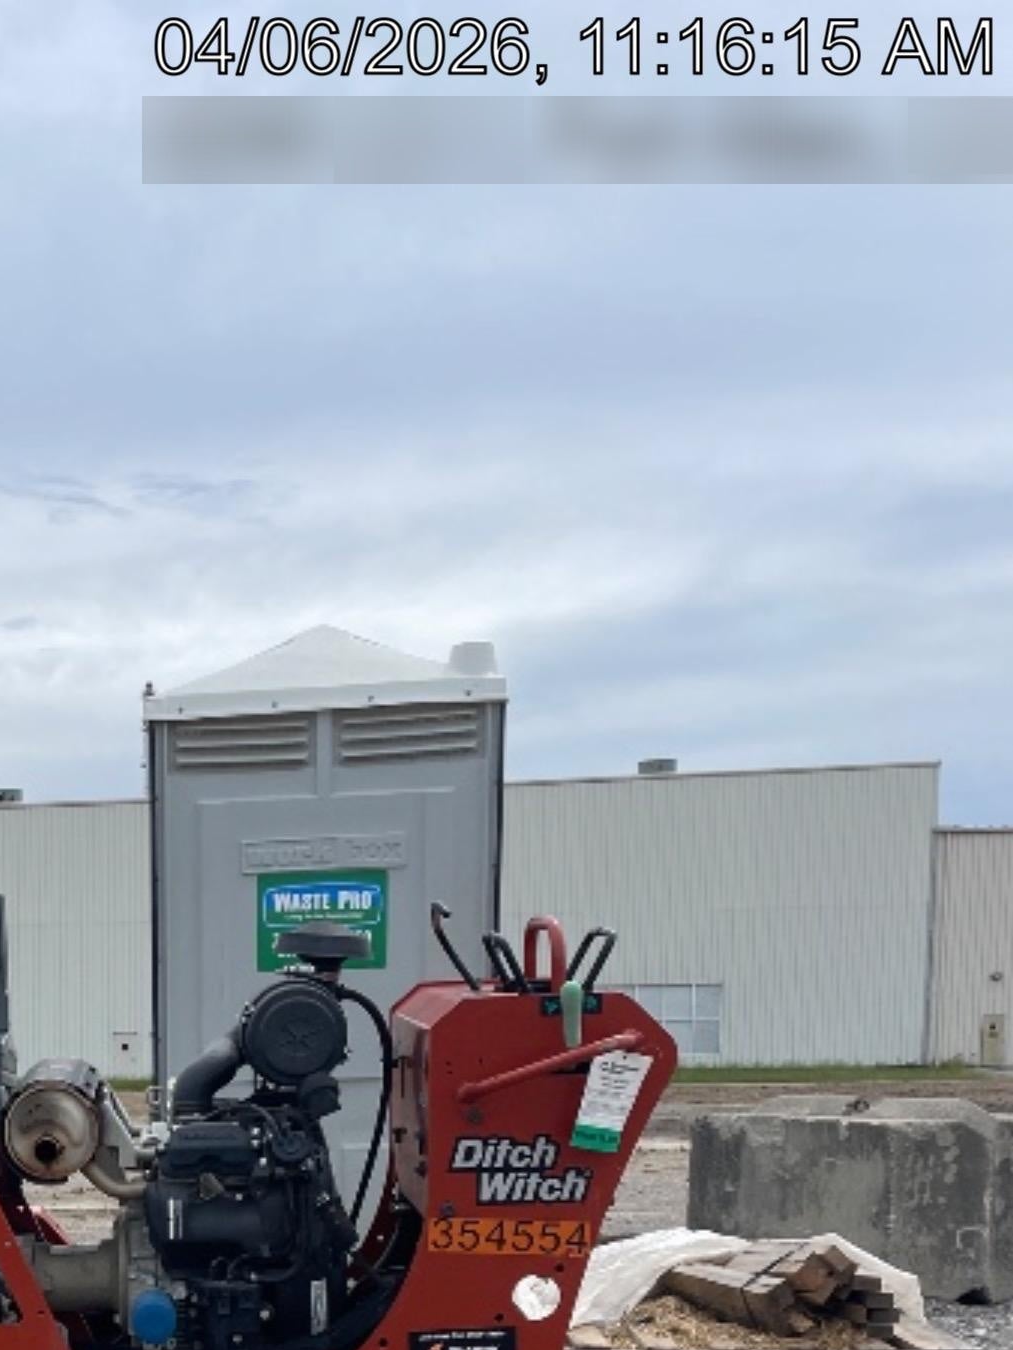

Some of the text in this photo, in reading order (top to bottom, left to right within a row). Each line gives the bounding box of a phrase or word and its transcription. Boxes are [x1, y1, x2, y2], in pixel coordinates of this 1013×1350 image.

[273, 890, 373, 914] WASTE PRO
[451, 1135, 557, 1169] Ditch
[479, 1169, 588, 1202] Witch
[430, 1219, 588, 1254] 354554
